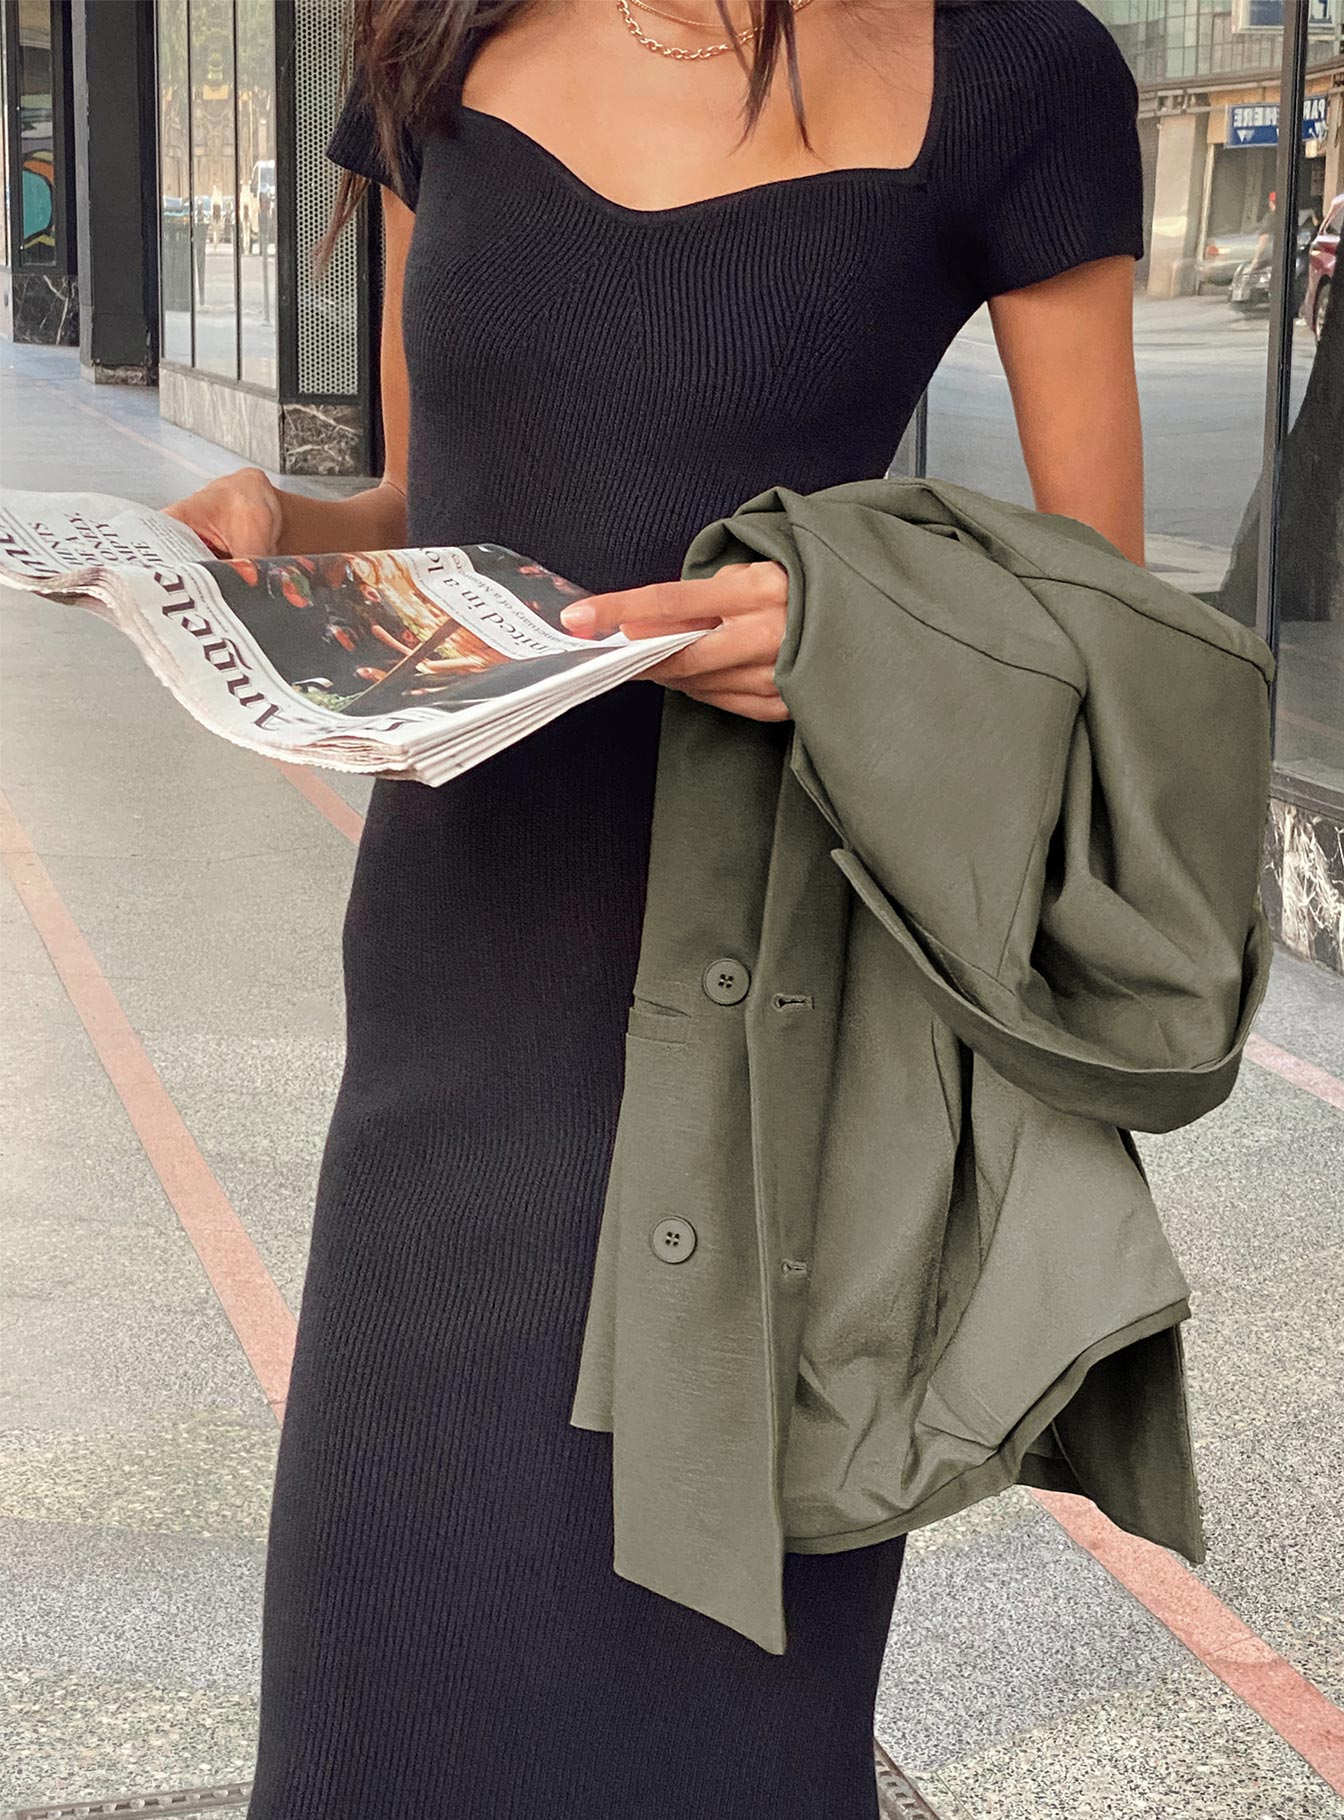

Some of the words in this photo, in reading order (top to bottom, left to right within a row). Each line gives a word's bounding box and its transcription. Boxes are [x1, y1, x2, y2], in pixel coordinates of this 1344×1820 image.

[29, 522, 85, 566] HINTS
[64, 512, 121, 563] ONELY,
[65, 536, 86, 545] A
[88, 519, 140, 563] MPTY
[76, 548, 105, 566] OF
[421, 548, 444, 574] lo
[443, 578, 460, 587] a
[461, 590, 486, 610] in
[496, 599, 513, 610] of
[480, 612, 552, 655] nited
[153, 571, 291, 731] Angele
